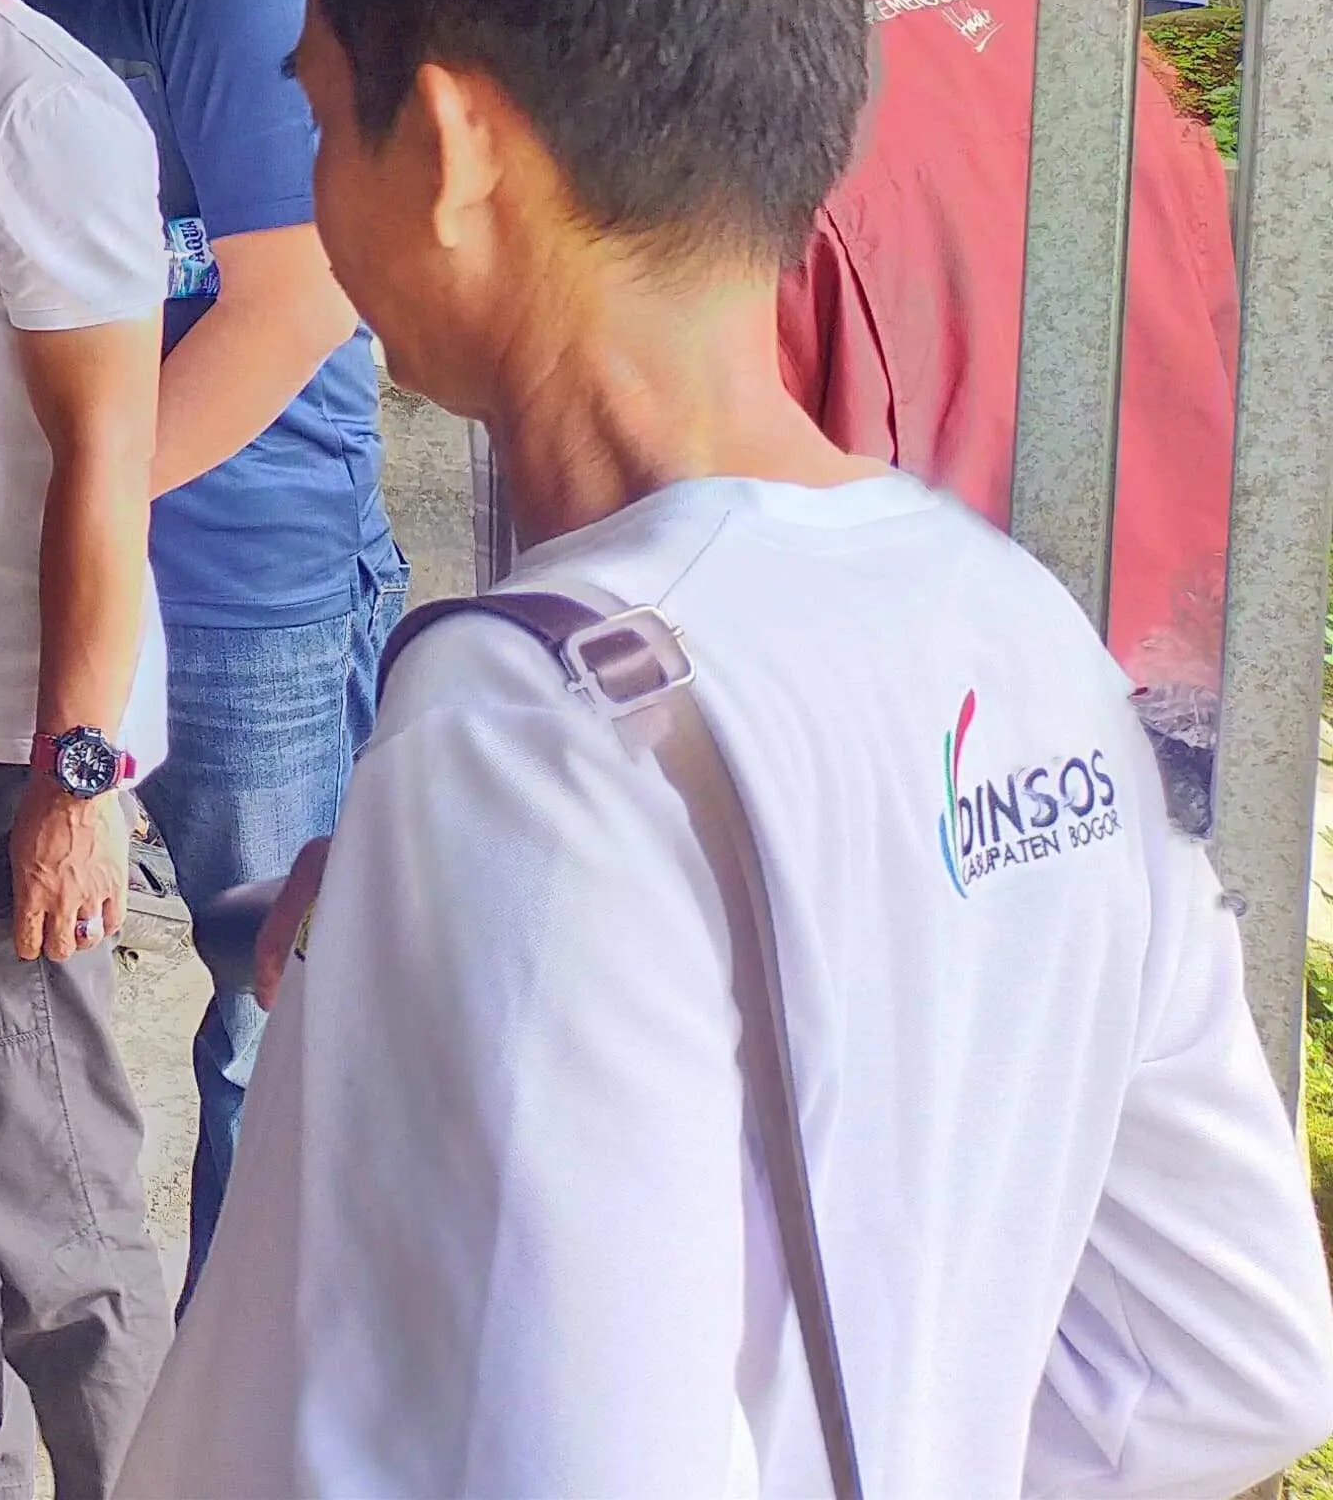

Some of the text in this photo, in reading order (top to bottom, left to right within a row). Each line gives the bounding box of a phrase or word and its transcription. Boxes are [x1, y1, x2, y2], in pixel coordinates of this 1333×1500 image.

[178, 220, 206, 264] AQUA
[957, 748, 1116, 857] DINSOS
[1067, 809, 1123, 848] BOGOR
